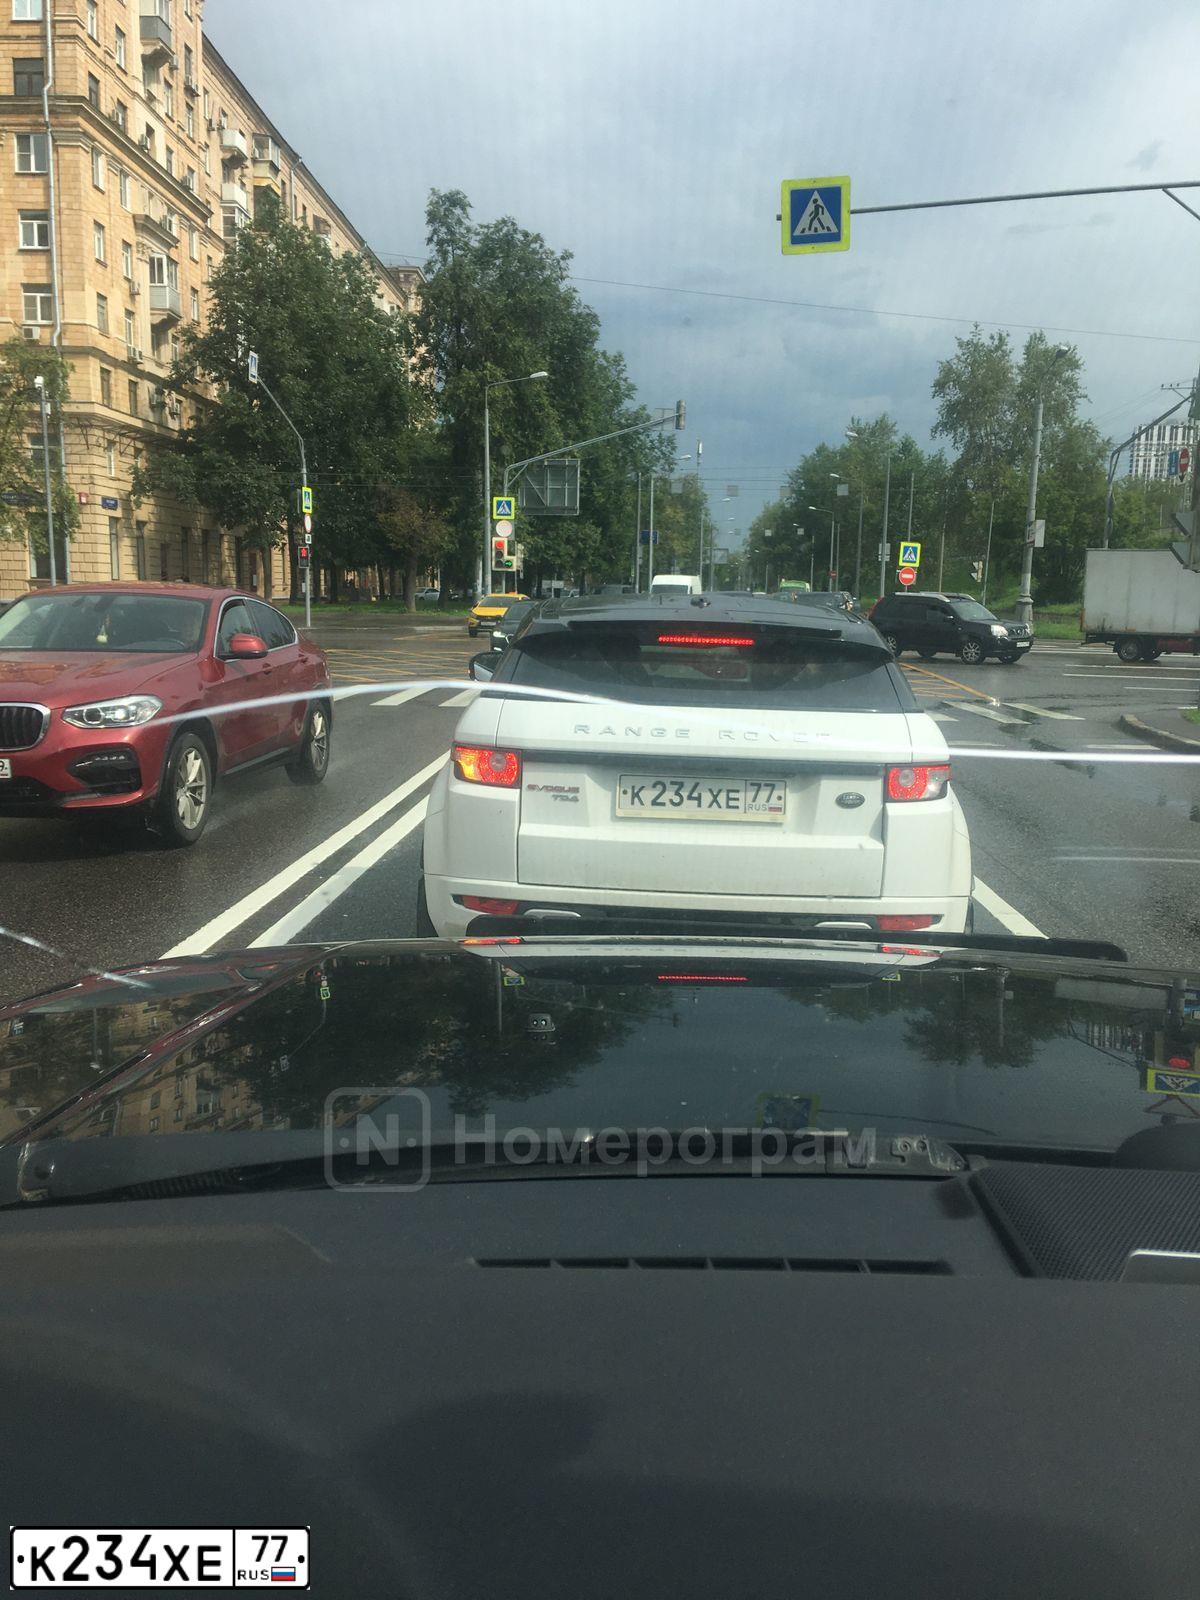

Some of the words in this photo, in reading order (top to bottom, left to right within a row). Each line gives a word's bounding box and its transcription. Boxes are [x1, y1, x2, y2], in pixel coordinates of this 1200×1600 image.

[574, 724, 691, 739] RANGE
[749, 782, 776, 804] 77
[747, 803, 768, 812] RUS
